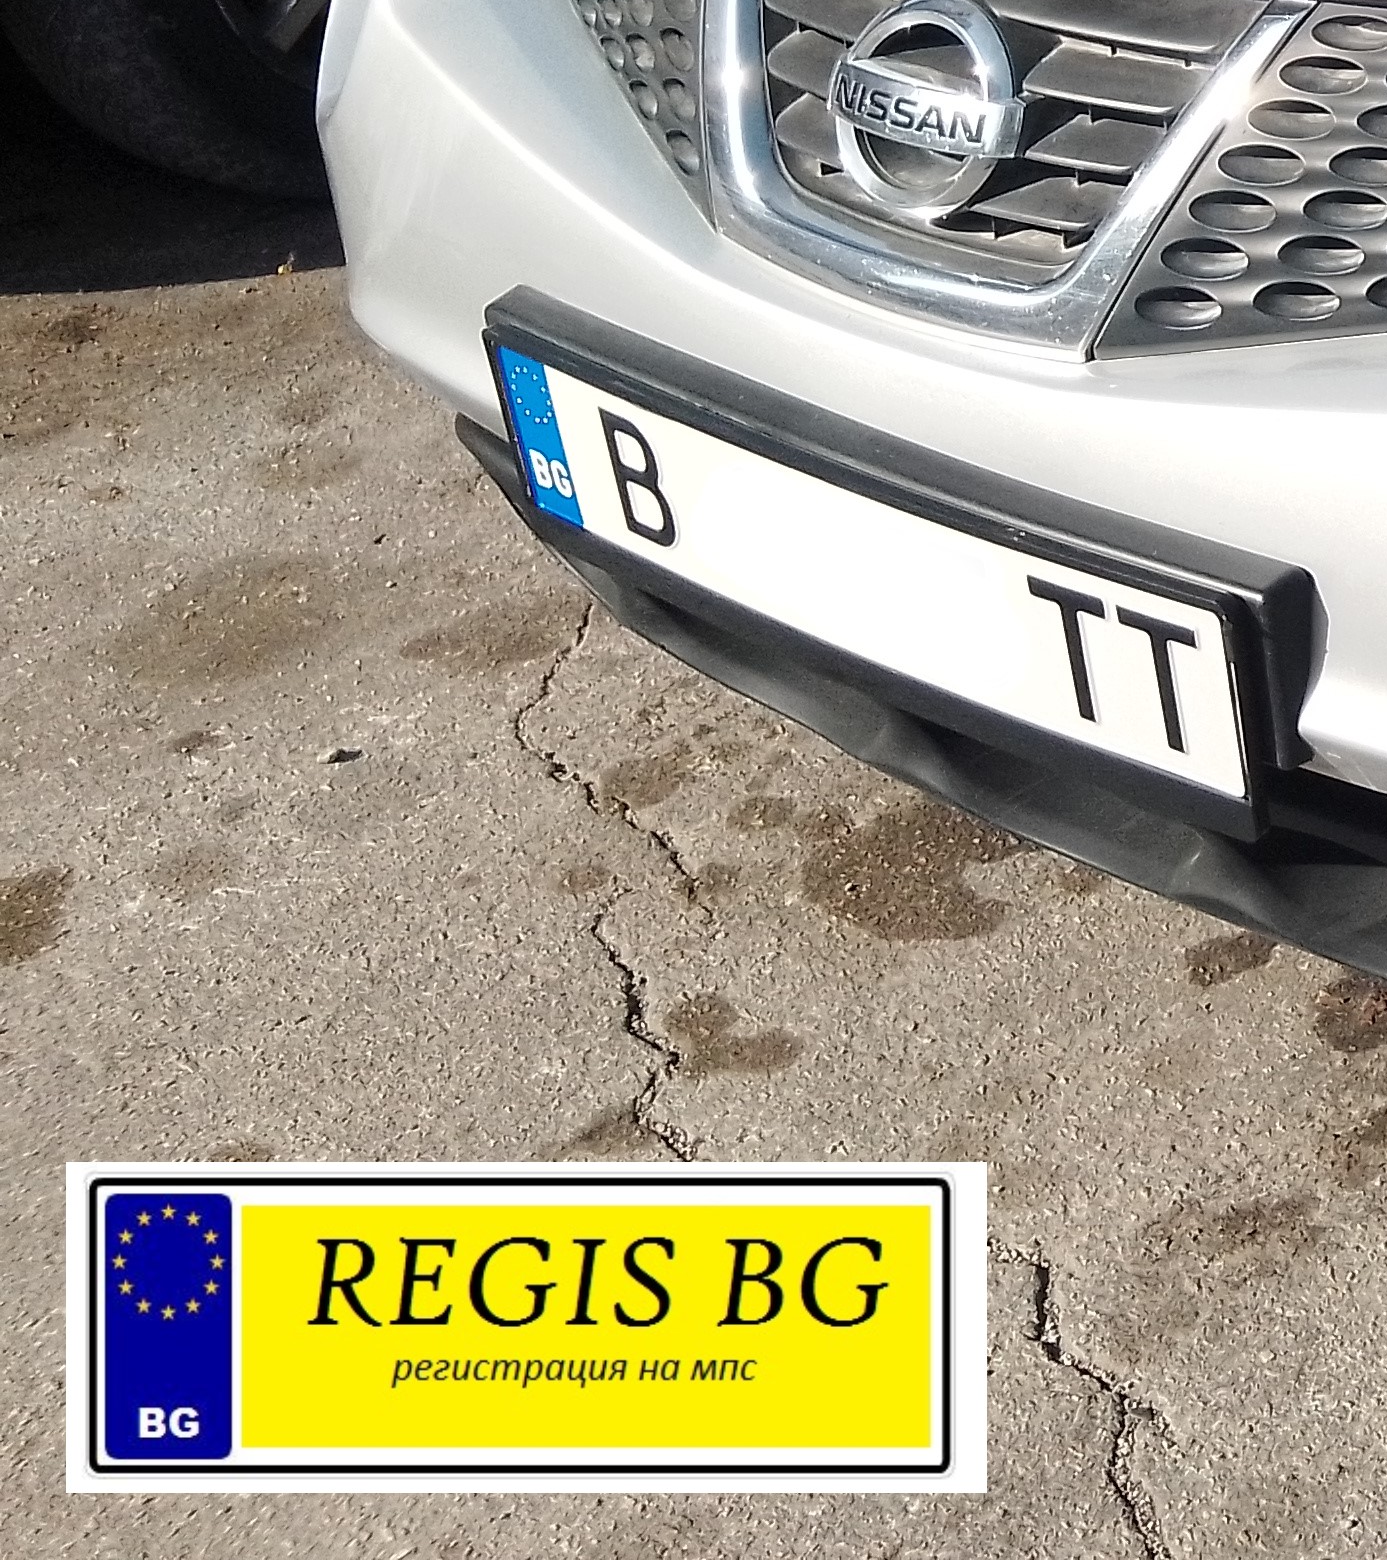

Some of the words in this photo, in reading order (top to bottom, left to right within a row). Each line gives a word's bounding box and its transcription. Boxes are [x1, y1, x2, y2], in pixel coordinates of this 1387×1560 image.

[835, 73, 986, 143] NISSAN
[532, 448, 573, 497] BG
[598, 407, 675, 547] B
[1027, 575, 1198, 752] TT
